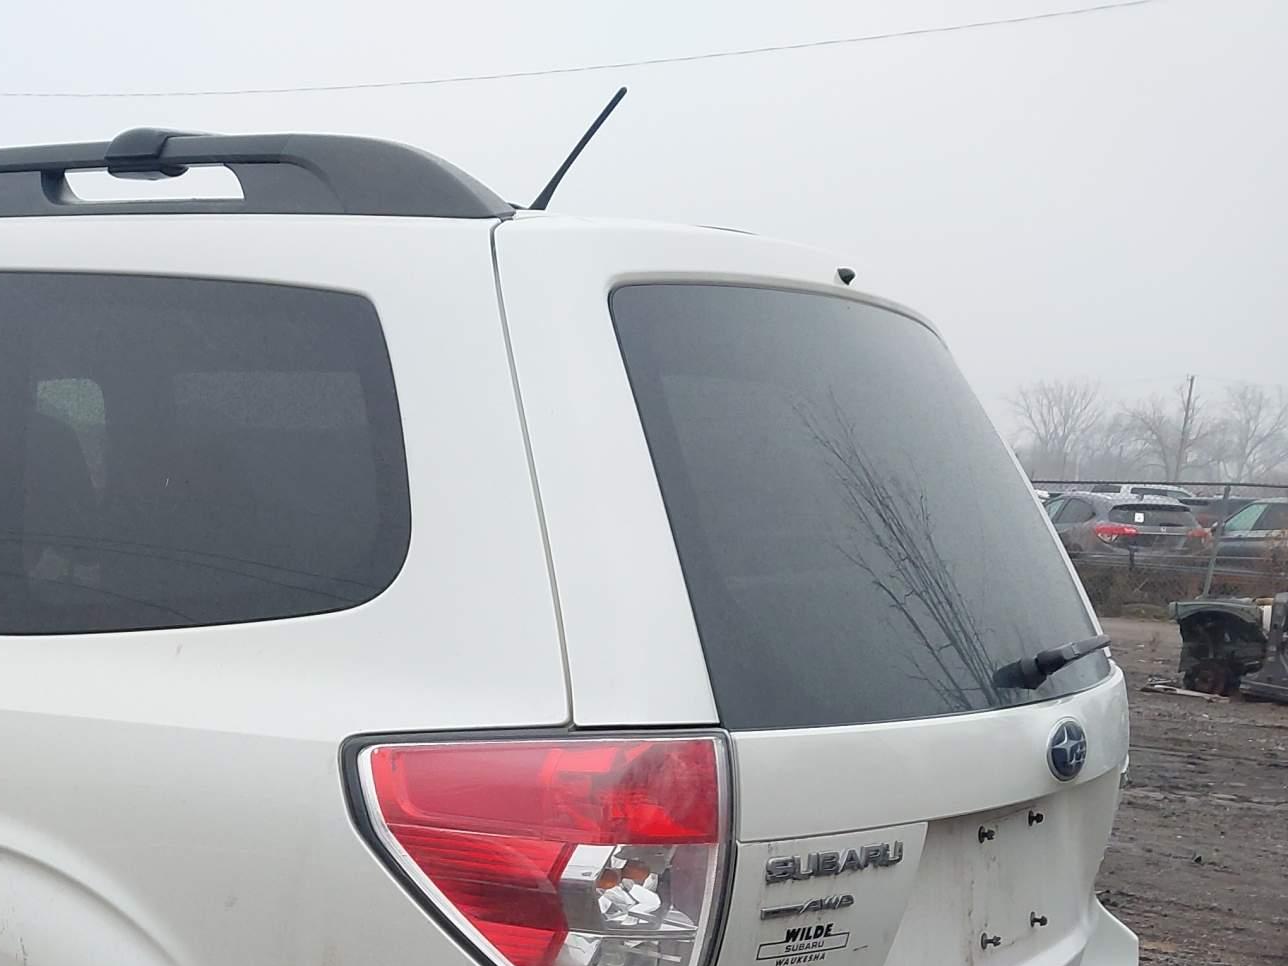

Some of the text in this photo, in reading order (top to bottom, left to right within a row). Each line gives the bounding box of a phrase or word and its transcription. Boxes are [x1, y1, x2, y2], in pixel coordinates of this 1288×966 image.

[766, 841, 903, 884] SUBARU
[785, 923, 834, 943] WILDE
[784, 940, 825, 953] SUBARU
[775, 952, 826, 966] WAUKESHA
